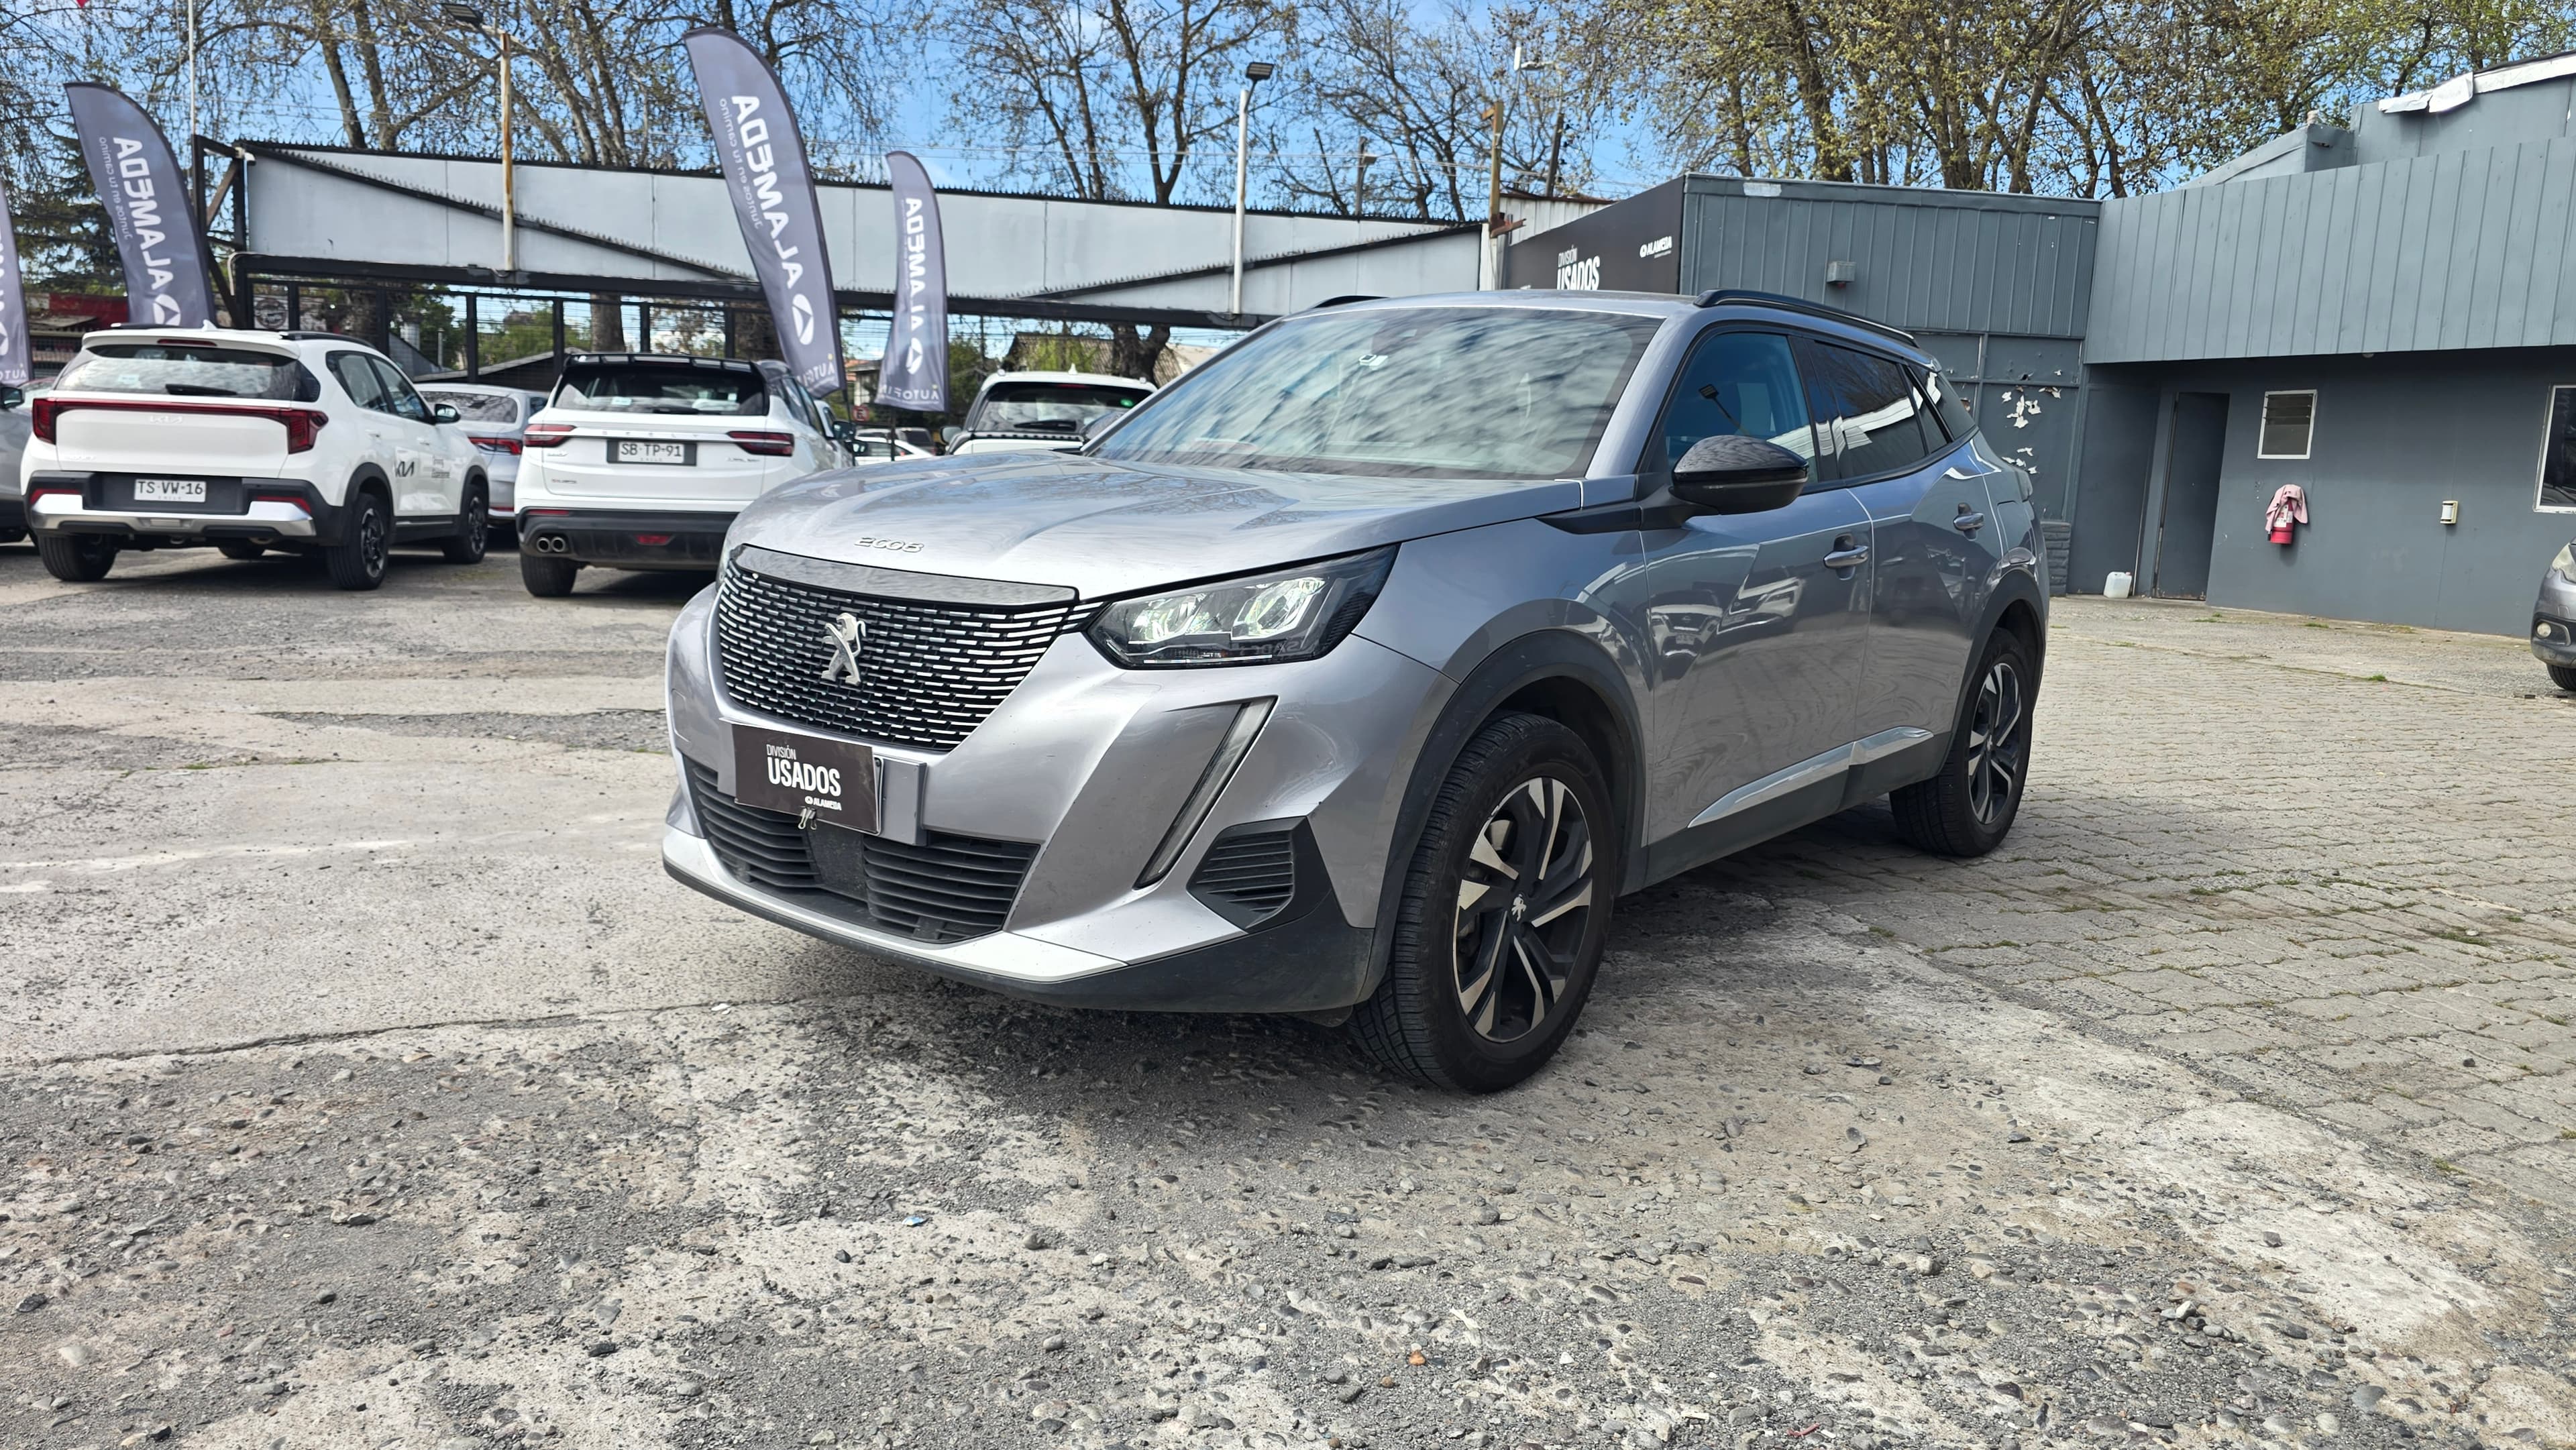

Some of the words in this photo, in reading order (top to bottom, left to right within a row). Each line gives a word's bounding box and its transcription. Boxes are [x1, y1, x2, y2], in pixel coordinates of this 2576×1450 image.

[1556, 256, 1600, 290] USADOS
[854, 537, 924, 553] 2008
[766, 744, 797, 761] DIVISIÓN
[767, 757, 841, 797] USADOS
